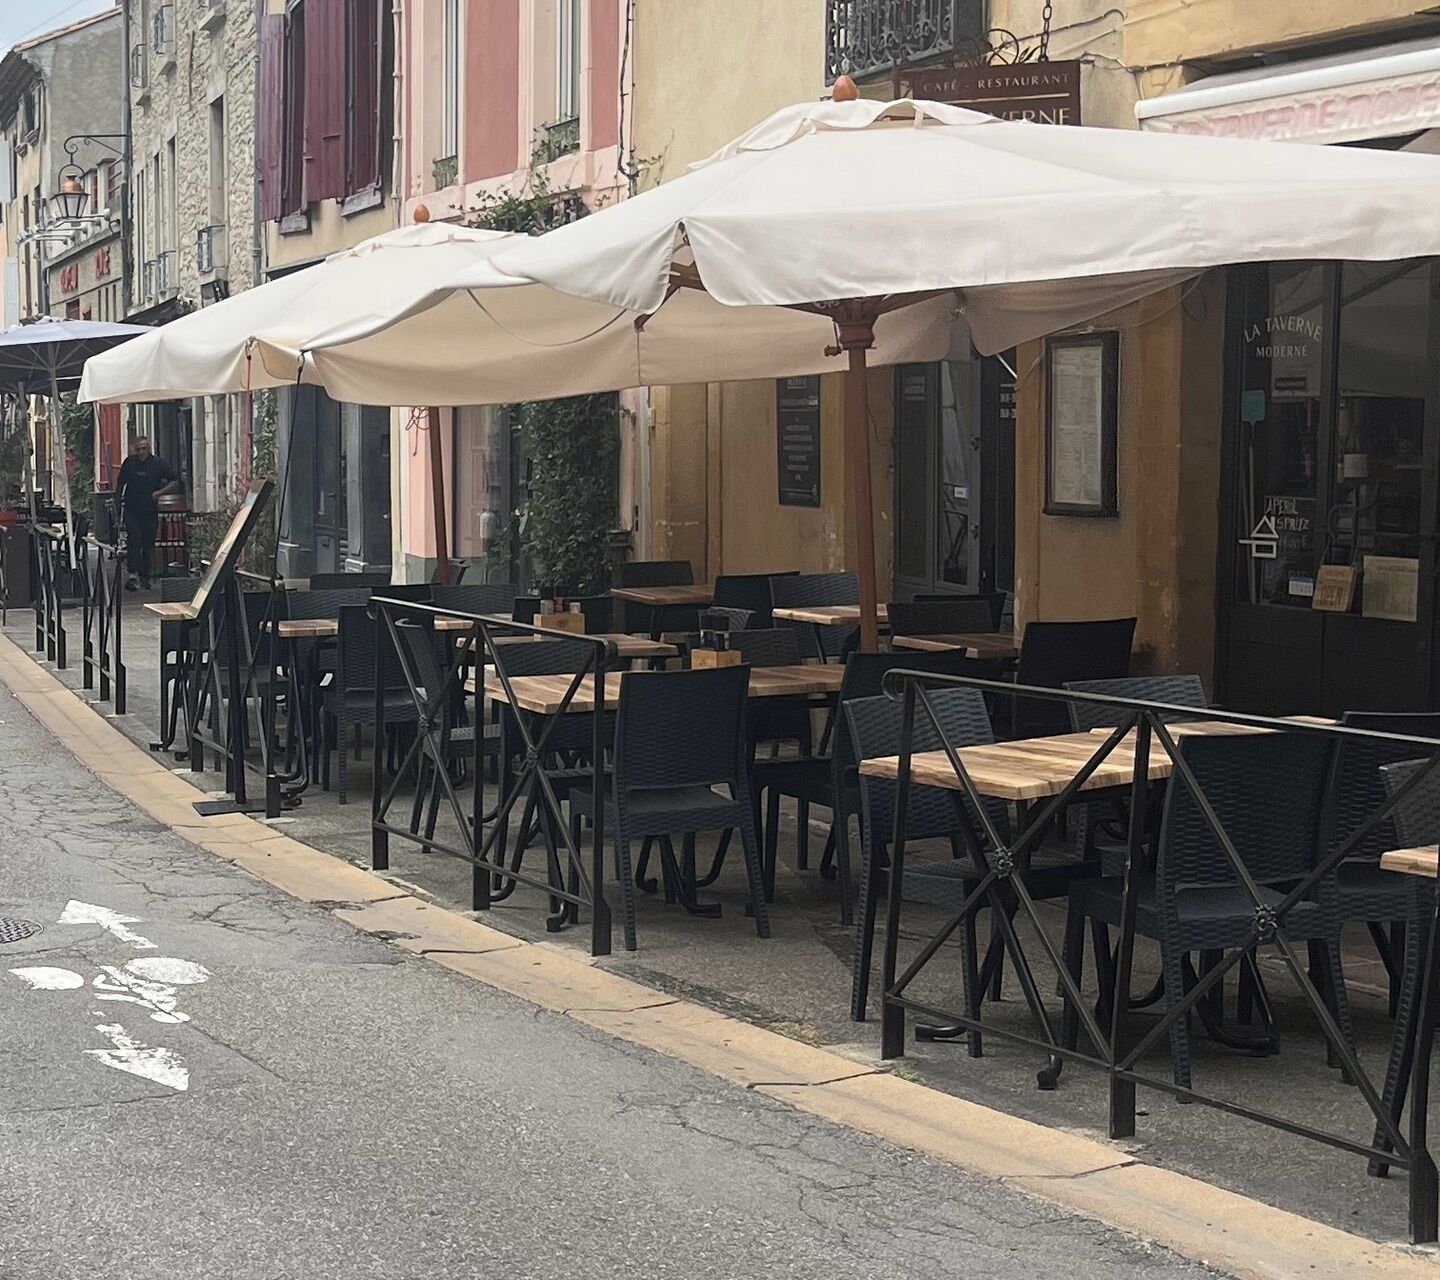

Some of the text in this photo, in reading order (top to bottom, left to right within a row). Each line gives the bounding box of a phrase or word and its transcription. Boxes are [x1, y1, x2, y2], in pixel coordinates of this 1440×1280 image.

[923, 78, 957, 92] CAFÉ
[977, 73, 1070, 90] RESTAURANT
[1244, 315, 1323, 344] LA TAVERNE
[1256, 345, 1308, 359] MODERNE
